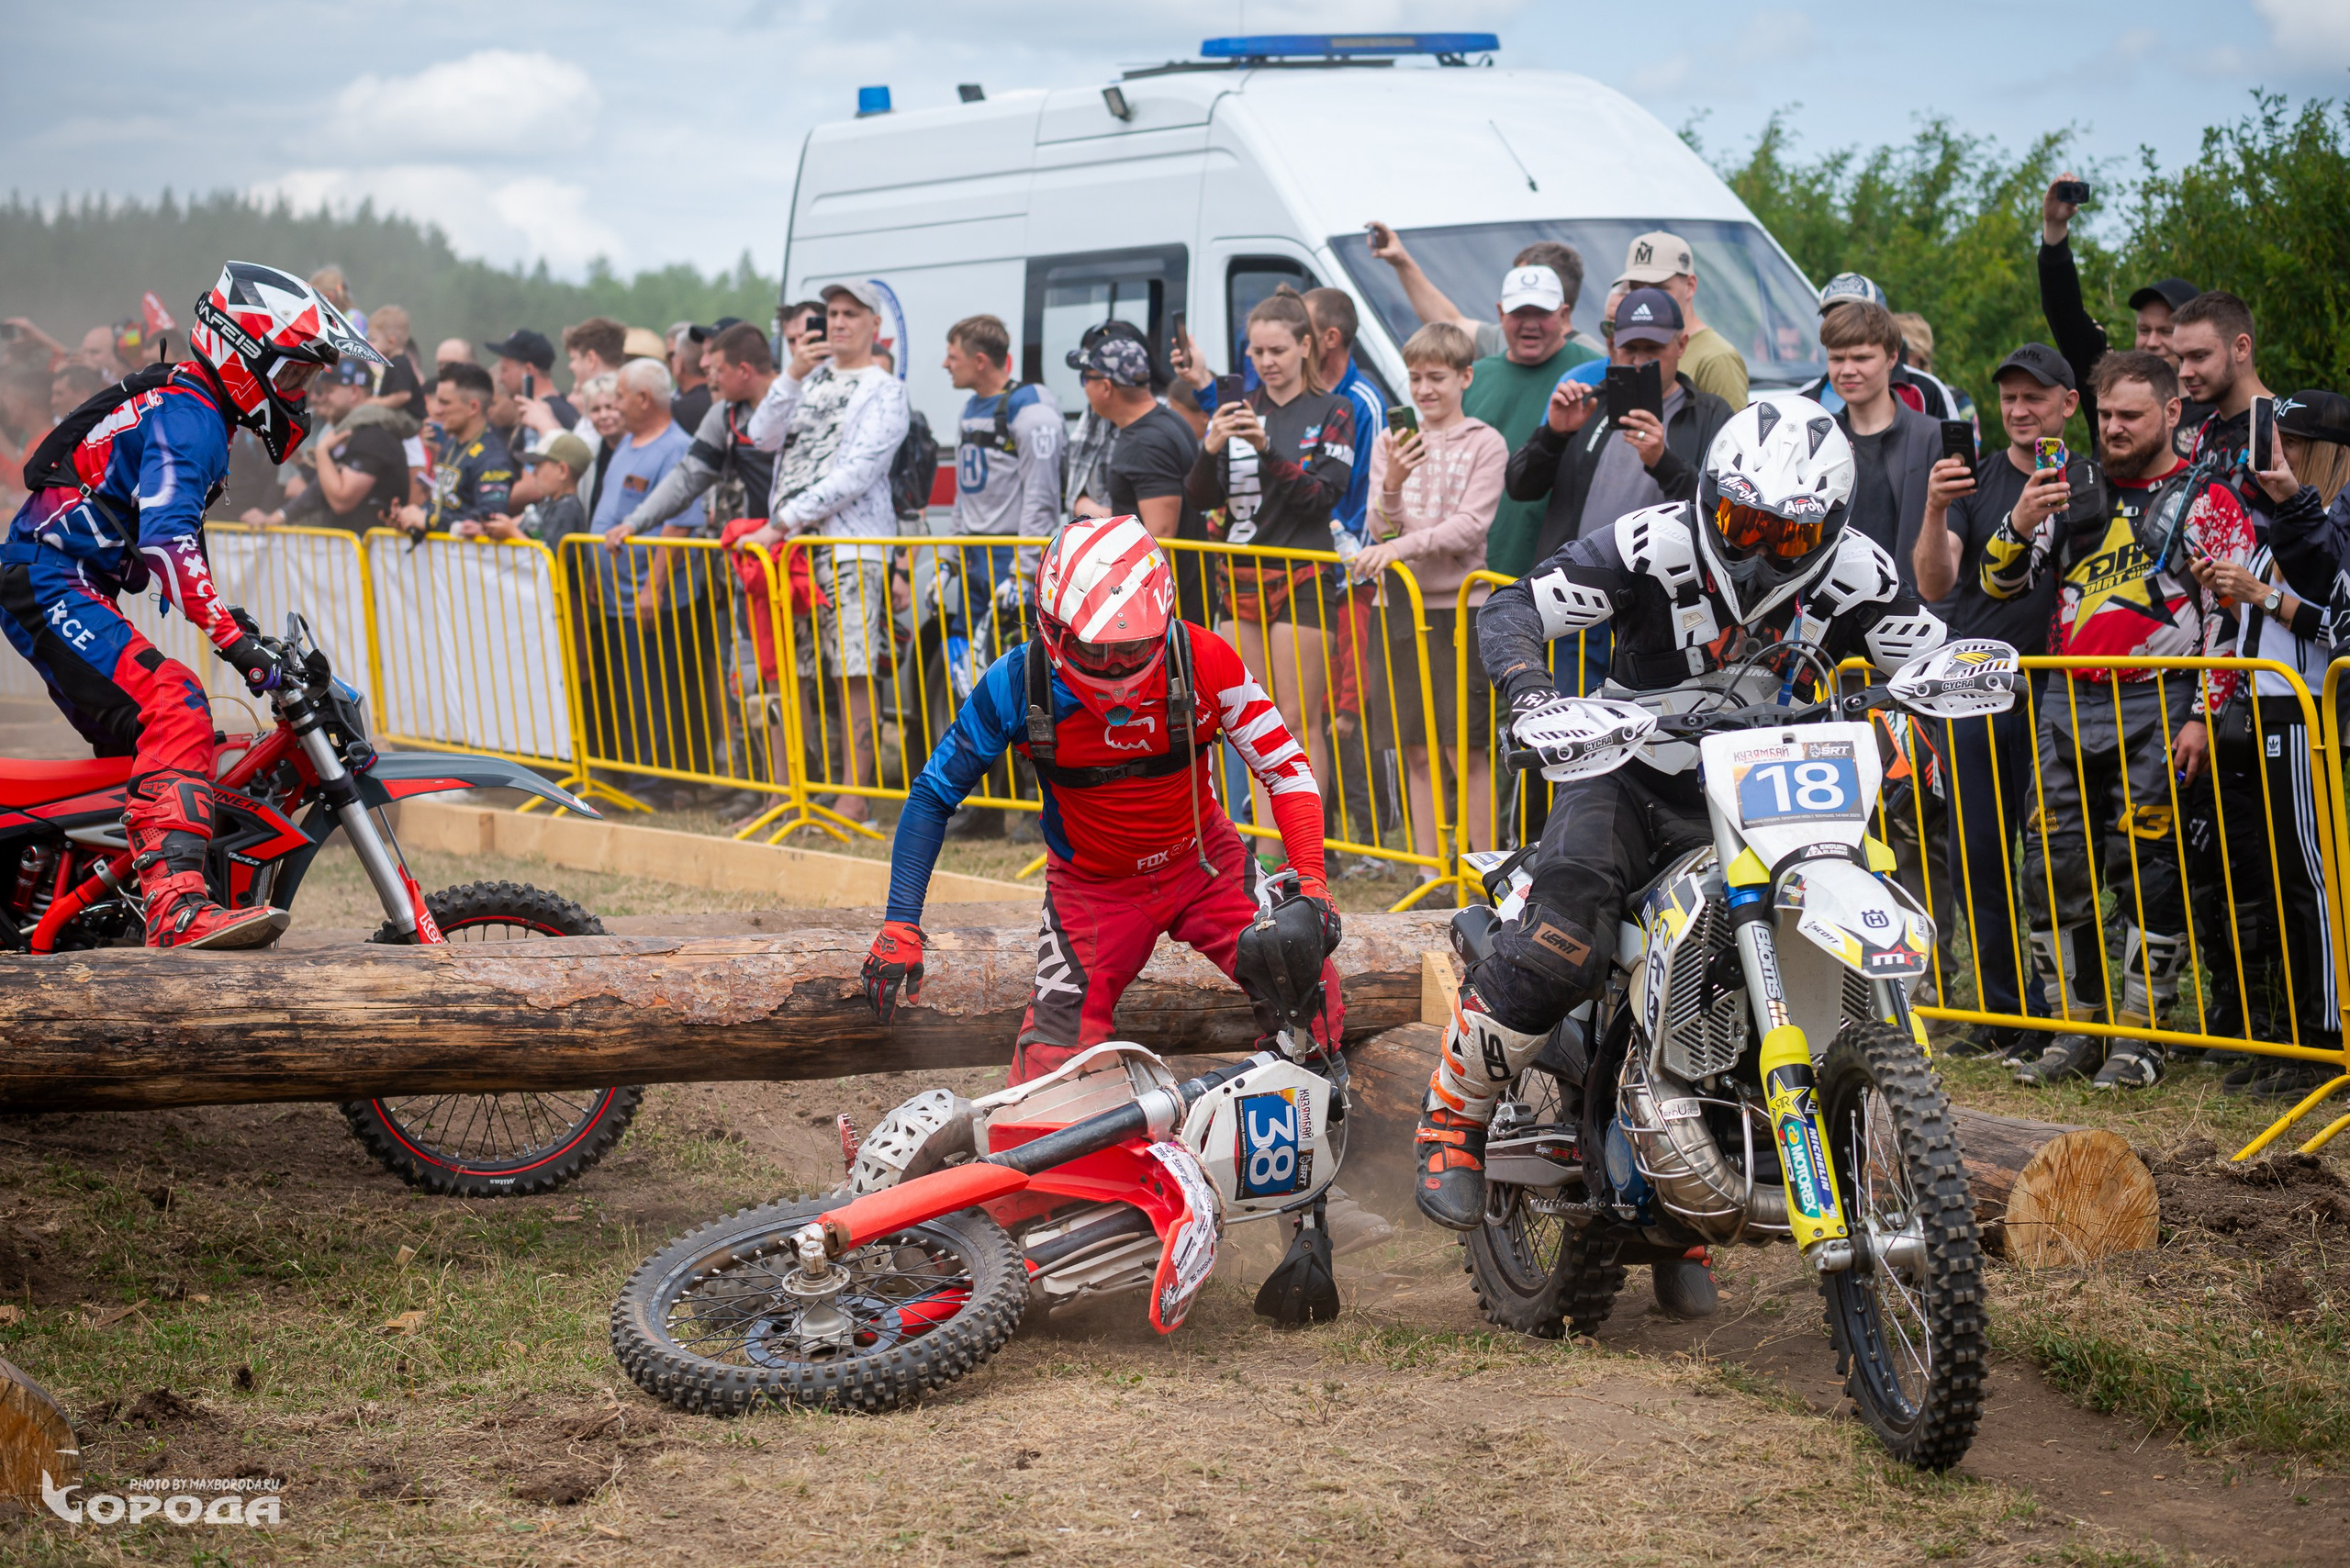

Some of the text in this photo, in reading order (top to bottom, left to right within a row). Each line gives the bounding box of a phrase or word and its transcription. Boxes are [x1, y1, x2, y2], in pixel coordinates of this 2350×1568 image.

[1718, 476, 1758, 505] Airoh
[1784, 497, 1827, 514] Airoh
[2082, 572, 2126, 597] DIRT
[1942, 679, 1975, 691] CYCRA
[1583, 735, 1614, 753] CYCRA
[1820, 745, 1850, 756] SRT
[1755, 761, 1845, 812] 18
[228, 852, 262, 866] Beta
[1136, 849, 1169, 871] FOX
[1811, 924, 1841, 944] SCOTT
[1752, 924, 1783, 1001] Bloms
[1299, 1088, 1315, 1139] КУЗЯМБАЙ
[1248, 1104, 1295, 1186] 38
[1807, 1126, 1830, 1193] MICHELIN
[489, 1177, 516, 1186] Mitas
[1297, 1164, 1307, 1186] SRT
[1789, 1143, 1817, 1215] MOTOREX
